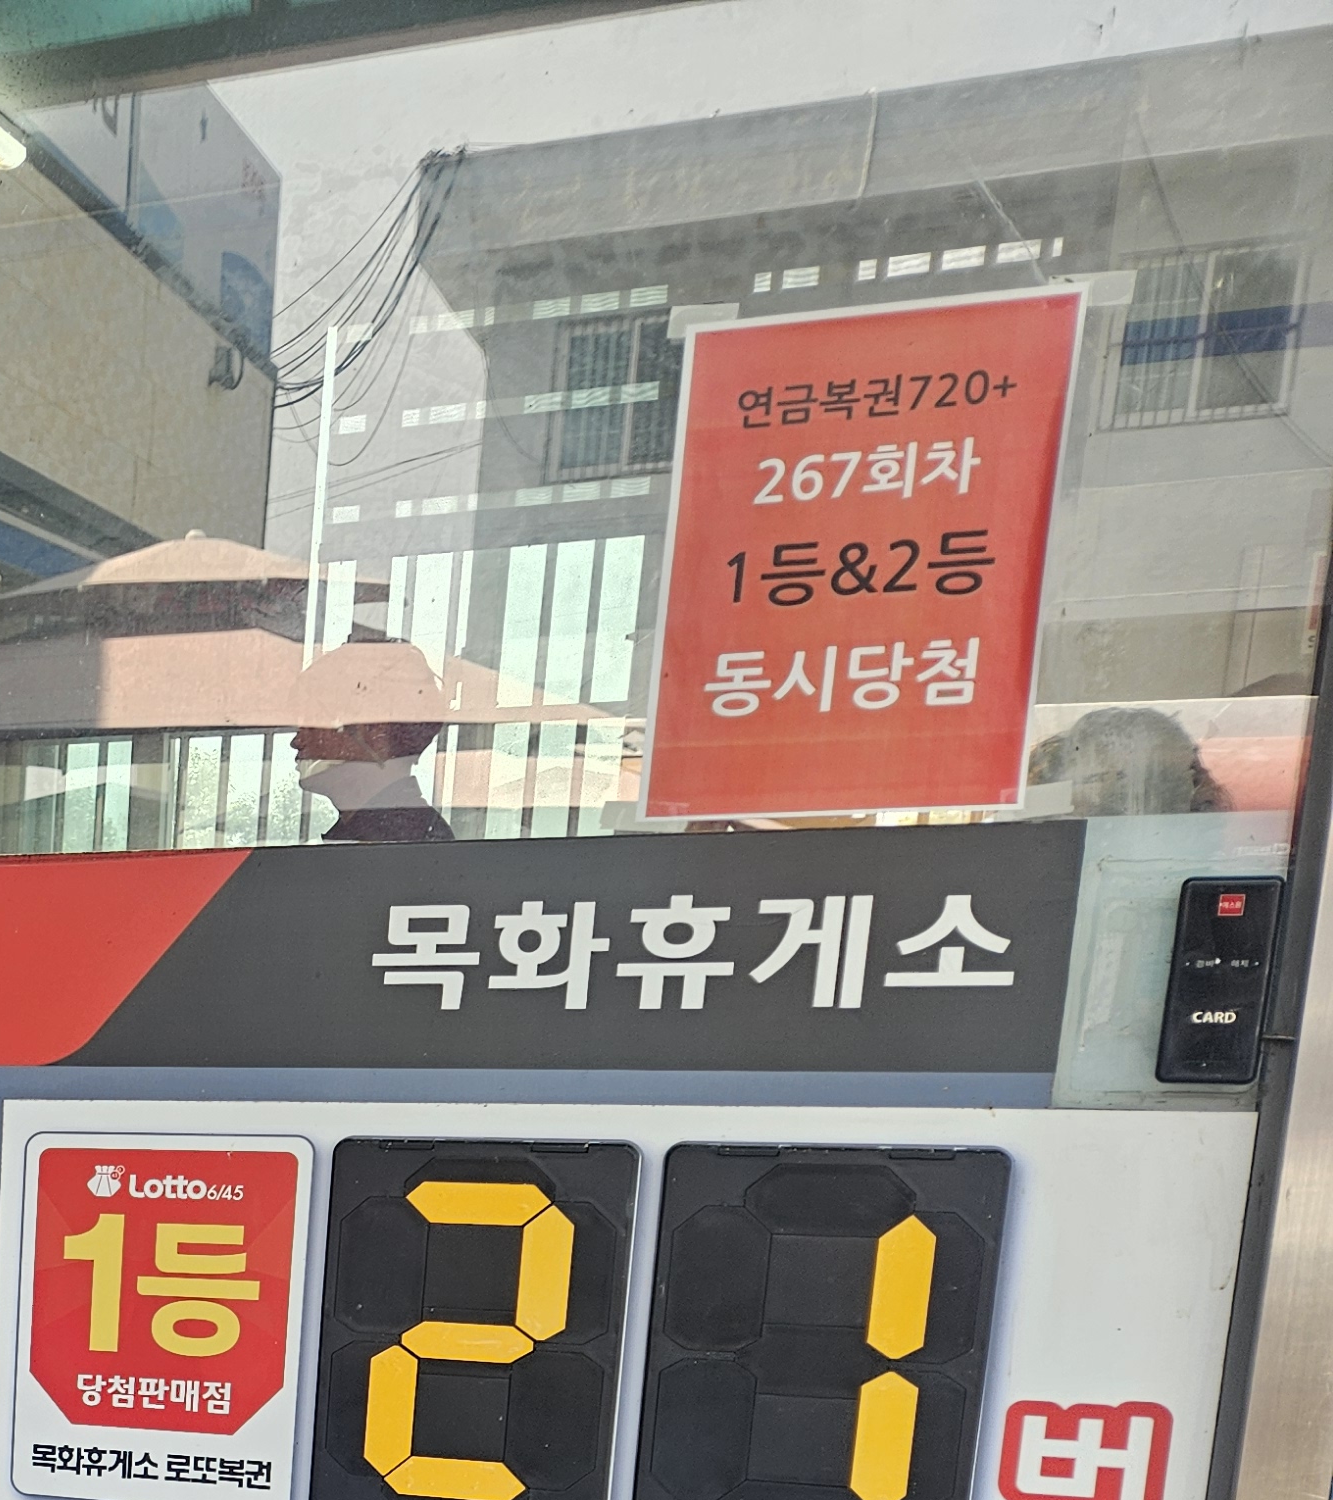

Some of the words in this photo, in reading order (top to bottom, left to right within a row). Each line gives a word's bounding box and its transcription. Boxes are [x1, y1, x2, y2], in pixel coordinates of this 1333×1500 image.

[738, 368, 1018, 429] 연금복권720+
[752, 436, 982, 505] 267회차
[726, 528, 997, 608] 1등&2등
[703, 637, 981, 717] 동시당첨
[371, 894, 1016, 1010] 목화휴게소
[1191, 1011, 1238, 1024] CARD
[63, 1212, 261, 1358] 1등
[76, 1374, 232, 1415] 당첨판매점
[32, 1444, 160, 1480] 목화휴게소
[164, 1453, 272, 1491] 로또복권
